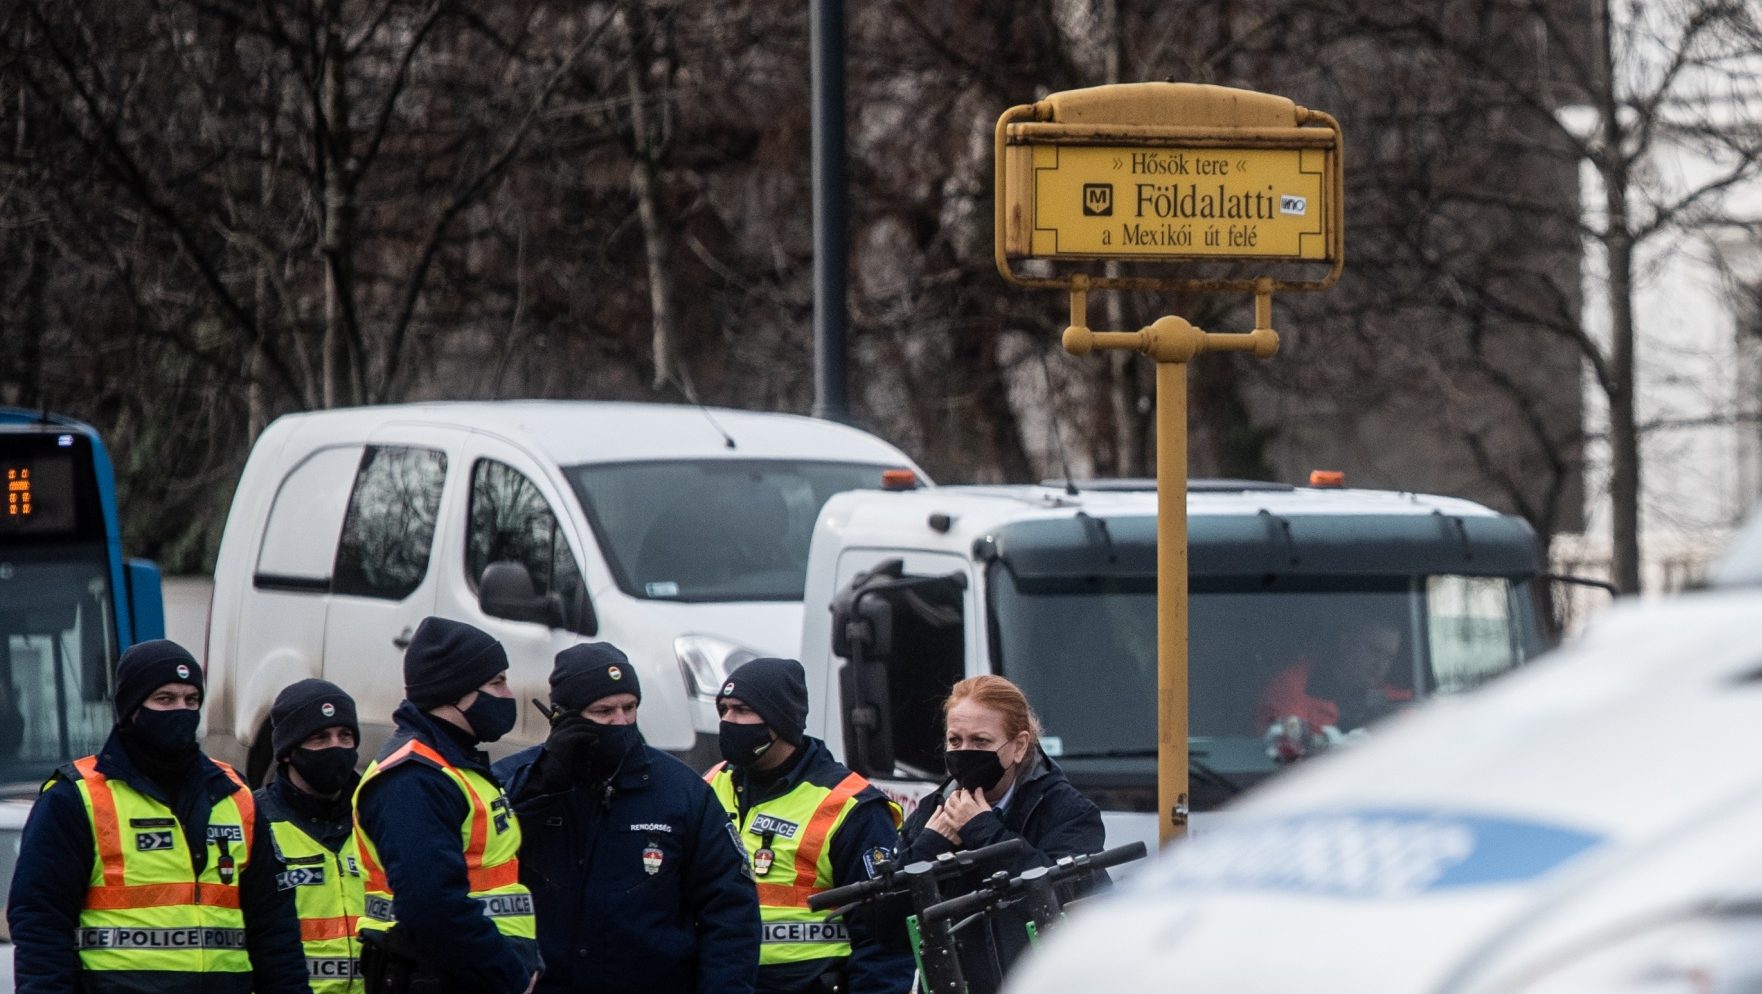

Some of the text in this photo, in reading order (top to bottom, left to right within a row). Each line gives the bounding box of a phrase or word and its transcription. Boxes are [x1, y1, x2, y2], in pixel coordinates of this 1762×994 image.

[1131, 151, 1190, 175] Hősök
[1195, 157, 1229, 175] tere
[1136, 183, 1274, 219] Földalatti
[1102, 223, 1257, 247] a Mexikói út felé
[206, 826, 241, 840] OLICE
[754, 816, 798, 837] POLICE
[367, 900, 389, 918] ICE
[119, 930, 199, 946] POLICE
[765, 924, 799, 941] ICE
[313, 960, 347, 976] ICE
